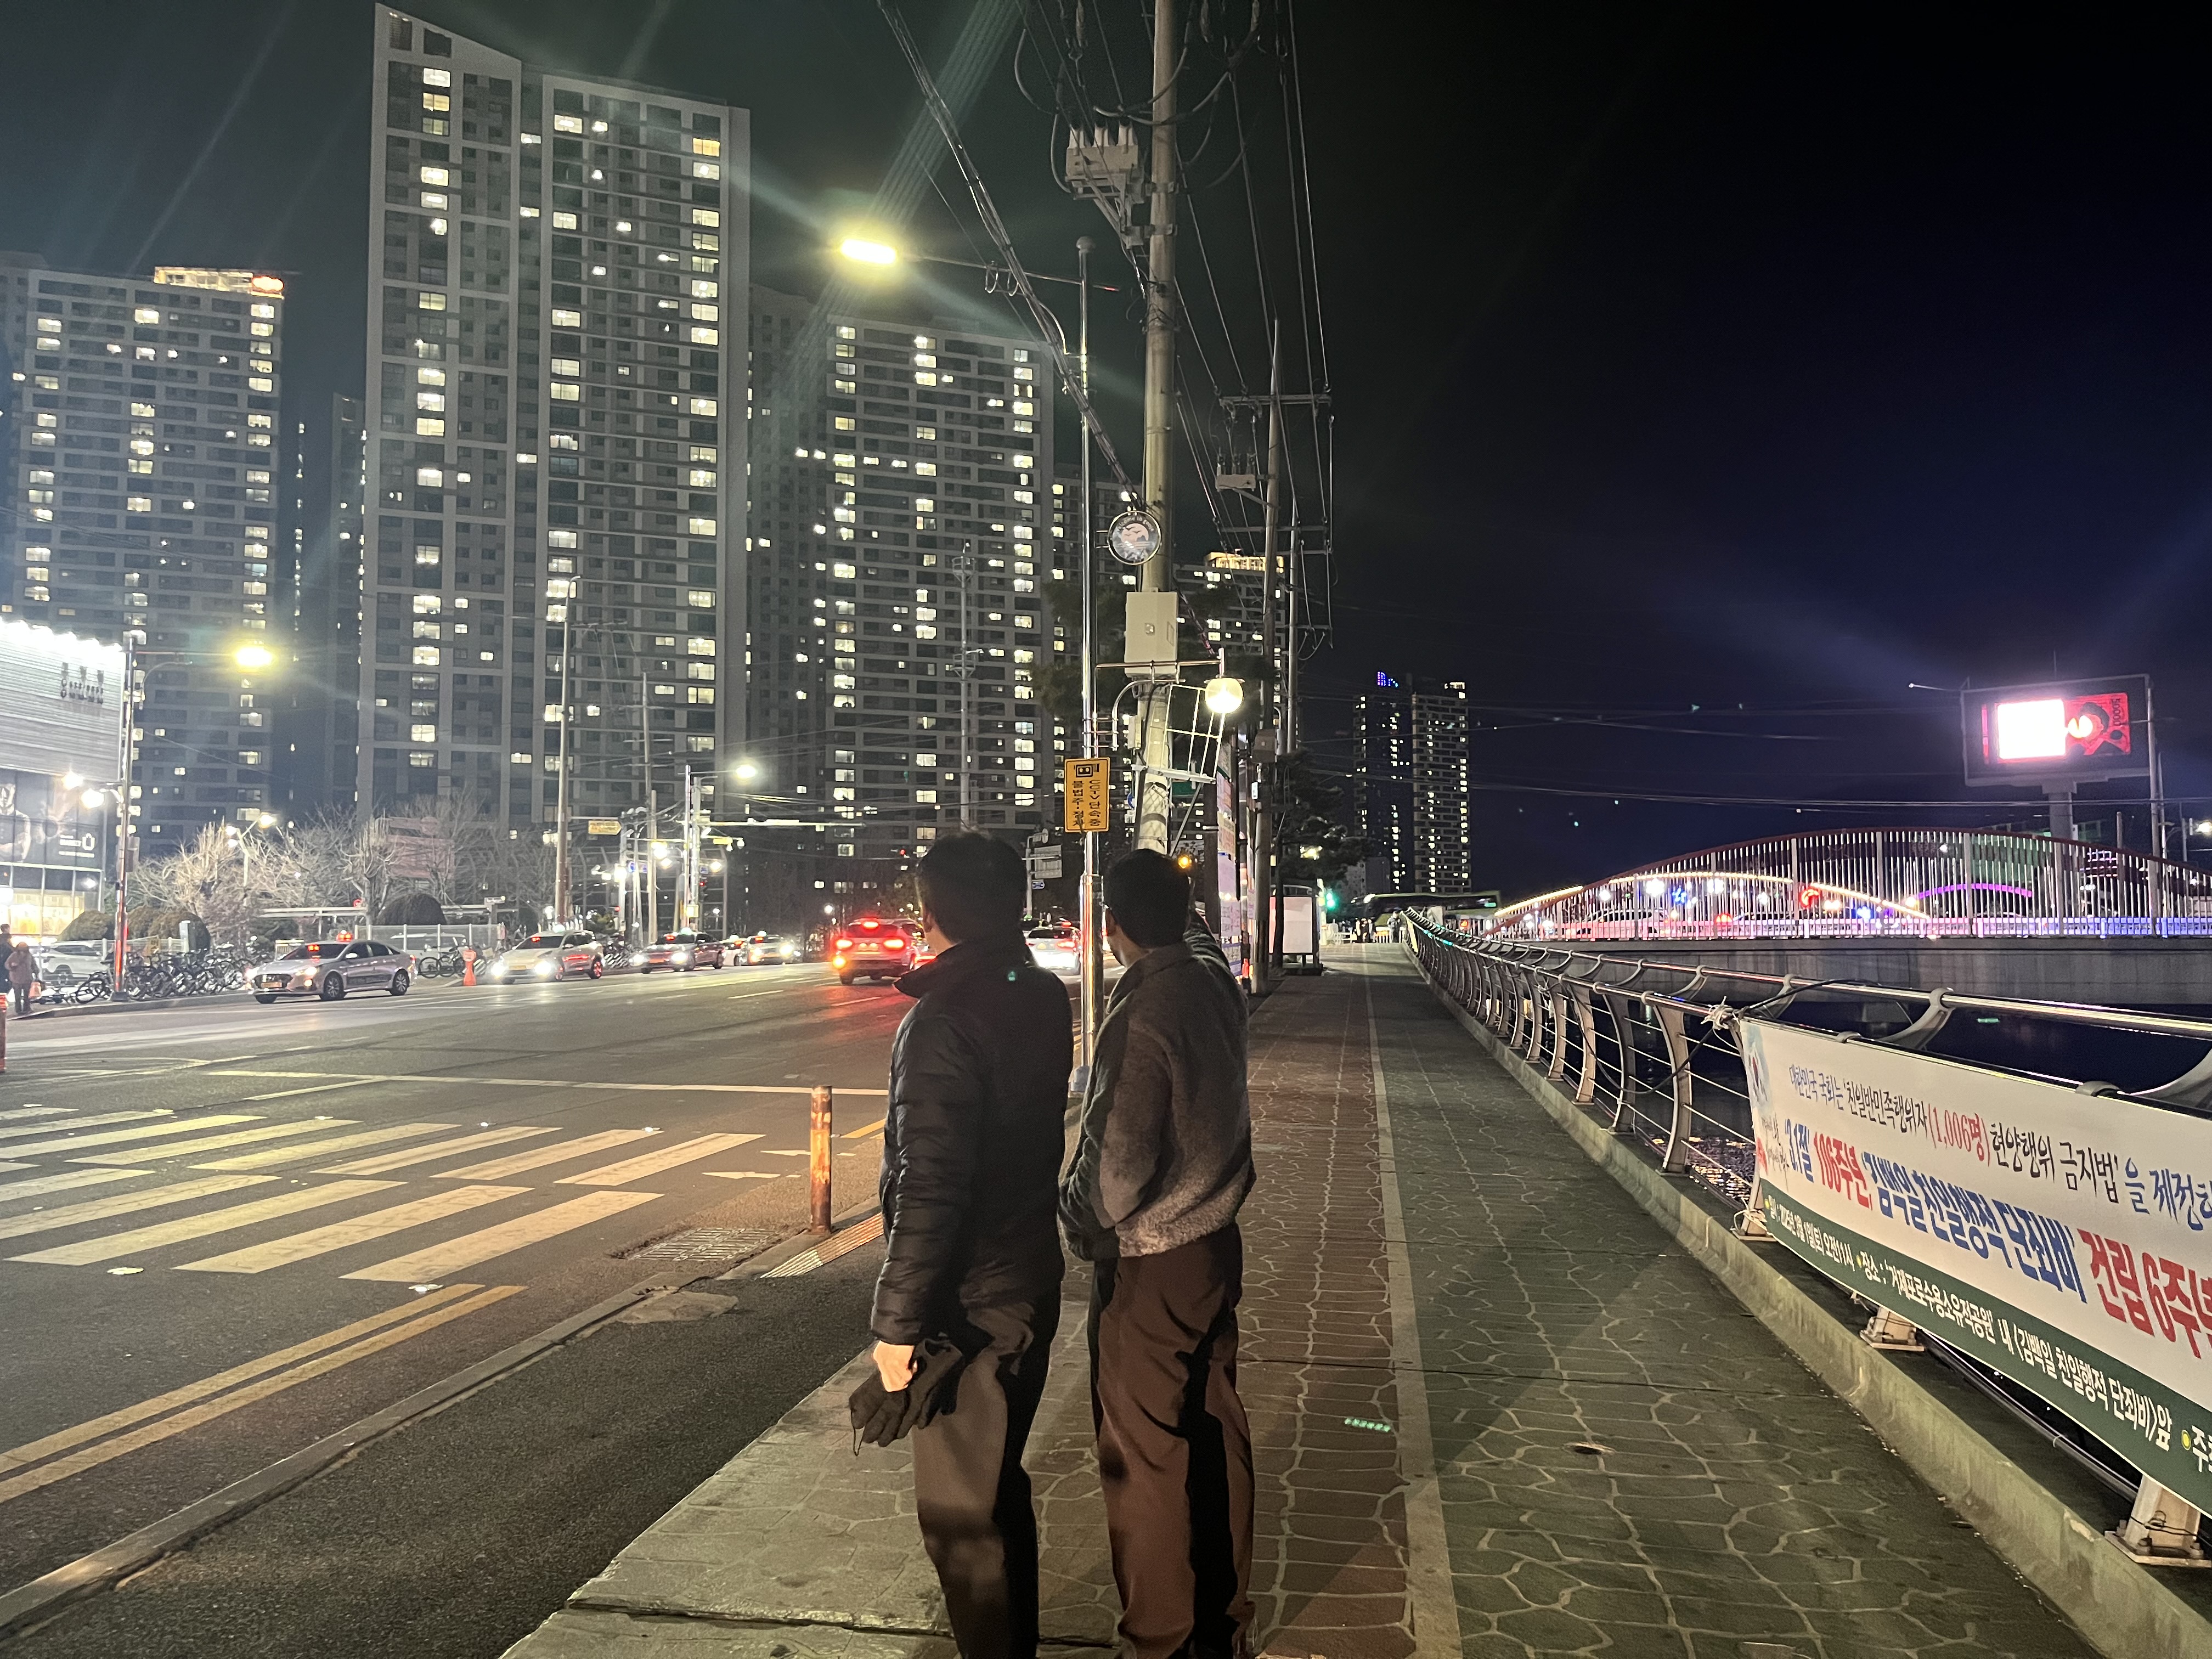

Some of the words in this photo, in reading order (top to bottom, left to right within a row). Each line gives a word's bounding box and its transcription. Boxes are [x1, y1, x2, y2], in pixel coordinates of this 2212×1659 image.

[1788, 1064, 1818, 1102] 대한민국
[1818, 1073, 1844, 1111] 국회는
[1989, 1122, 2055, 1183] 현양행위
[1911, 1169, 2013, 1269] 친일행적
[2076, 1228, 2155, 1338] 건립
[1997, 1318, 2015, 1355] 내
[2055, 1346, 2108, 1412] 친일행적
